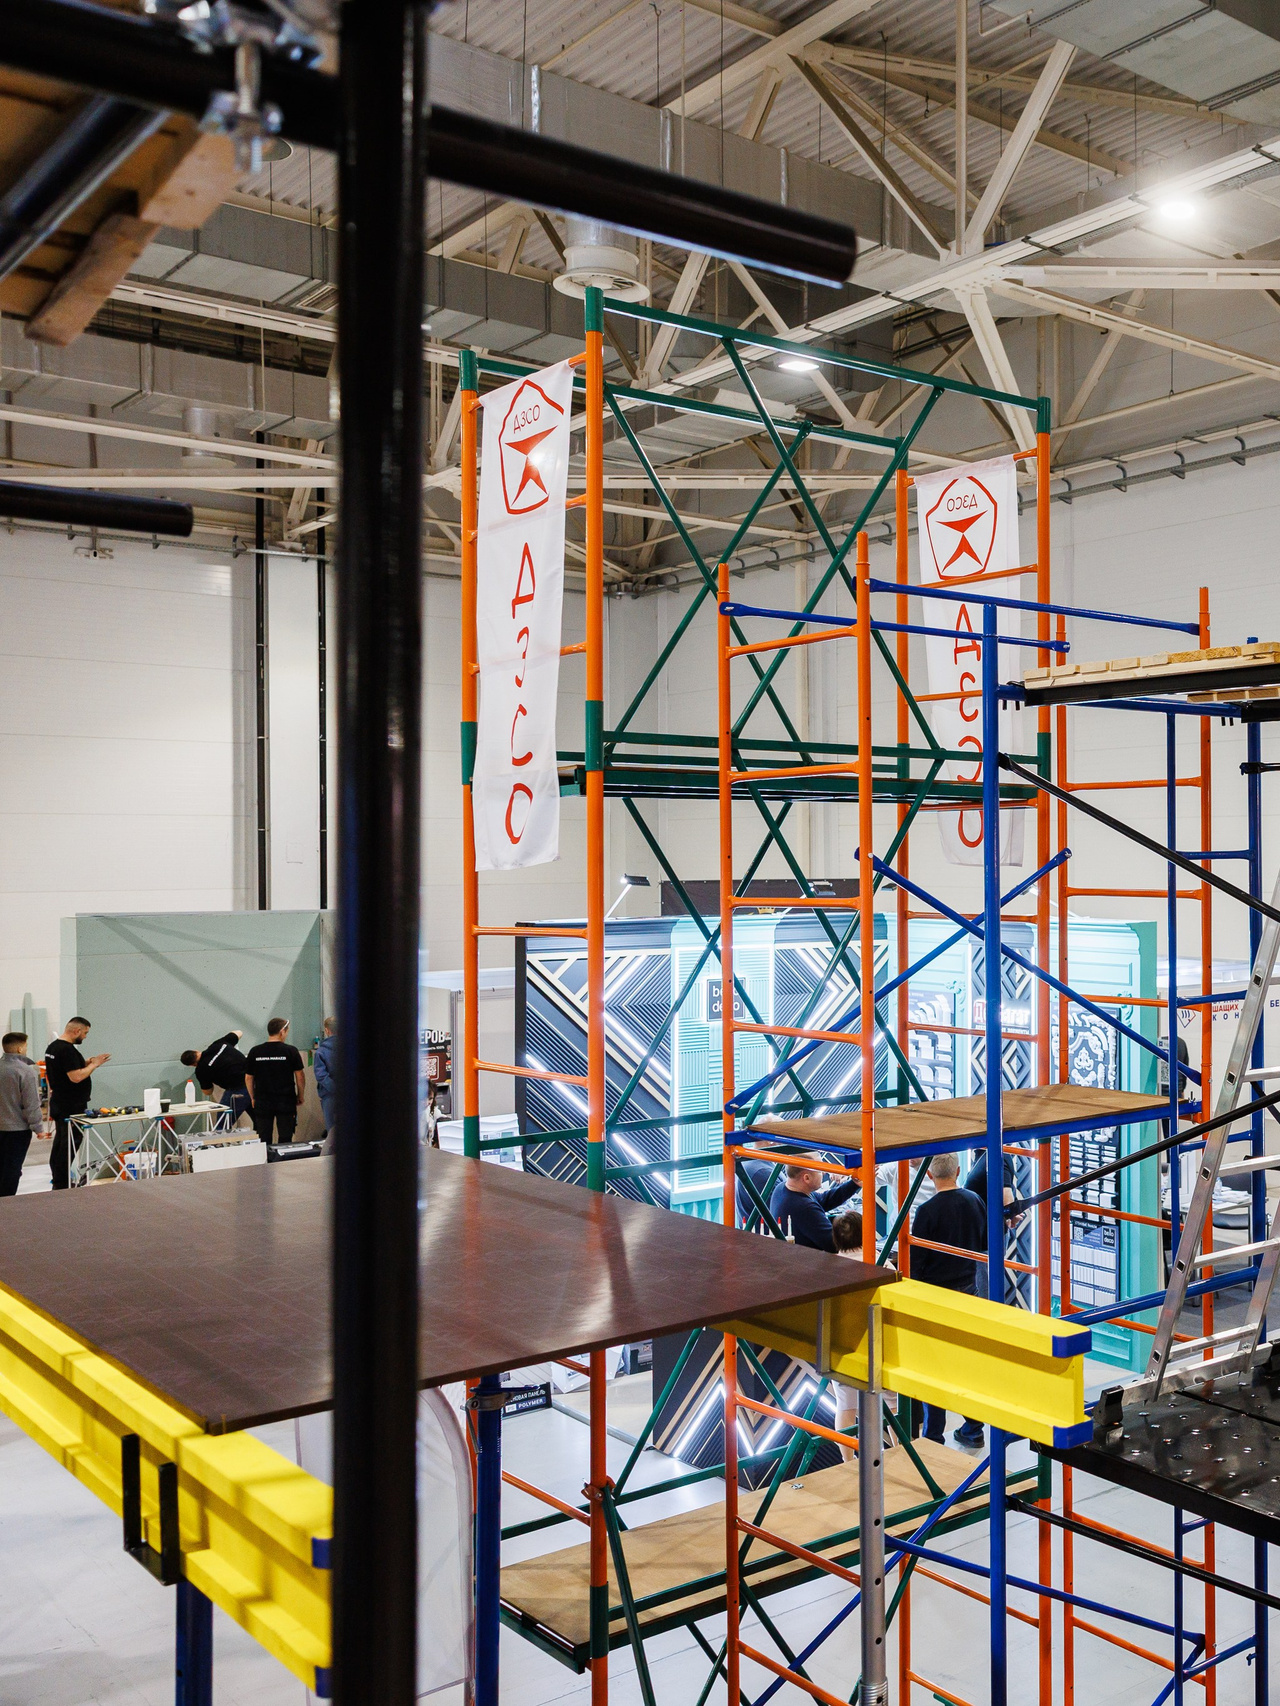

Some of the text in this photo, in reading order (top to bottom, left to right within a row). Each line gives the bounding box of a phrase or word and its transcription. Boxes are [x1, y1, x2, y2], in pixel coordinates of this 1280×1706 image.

[513, 404, 541, 434] ДЗСО
[504, 541, 536, 846] ДЗСО
[1212, 1003, 1239, 1013] ШАЩИХ
[420, 1029, 446, 1045] ЕРОВ
[528, 1389, 546, 1398] ПАНЕЛЬ
[518, 1398, 544, 1409] POLYMER
